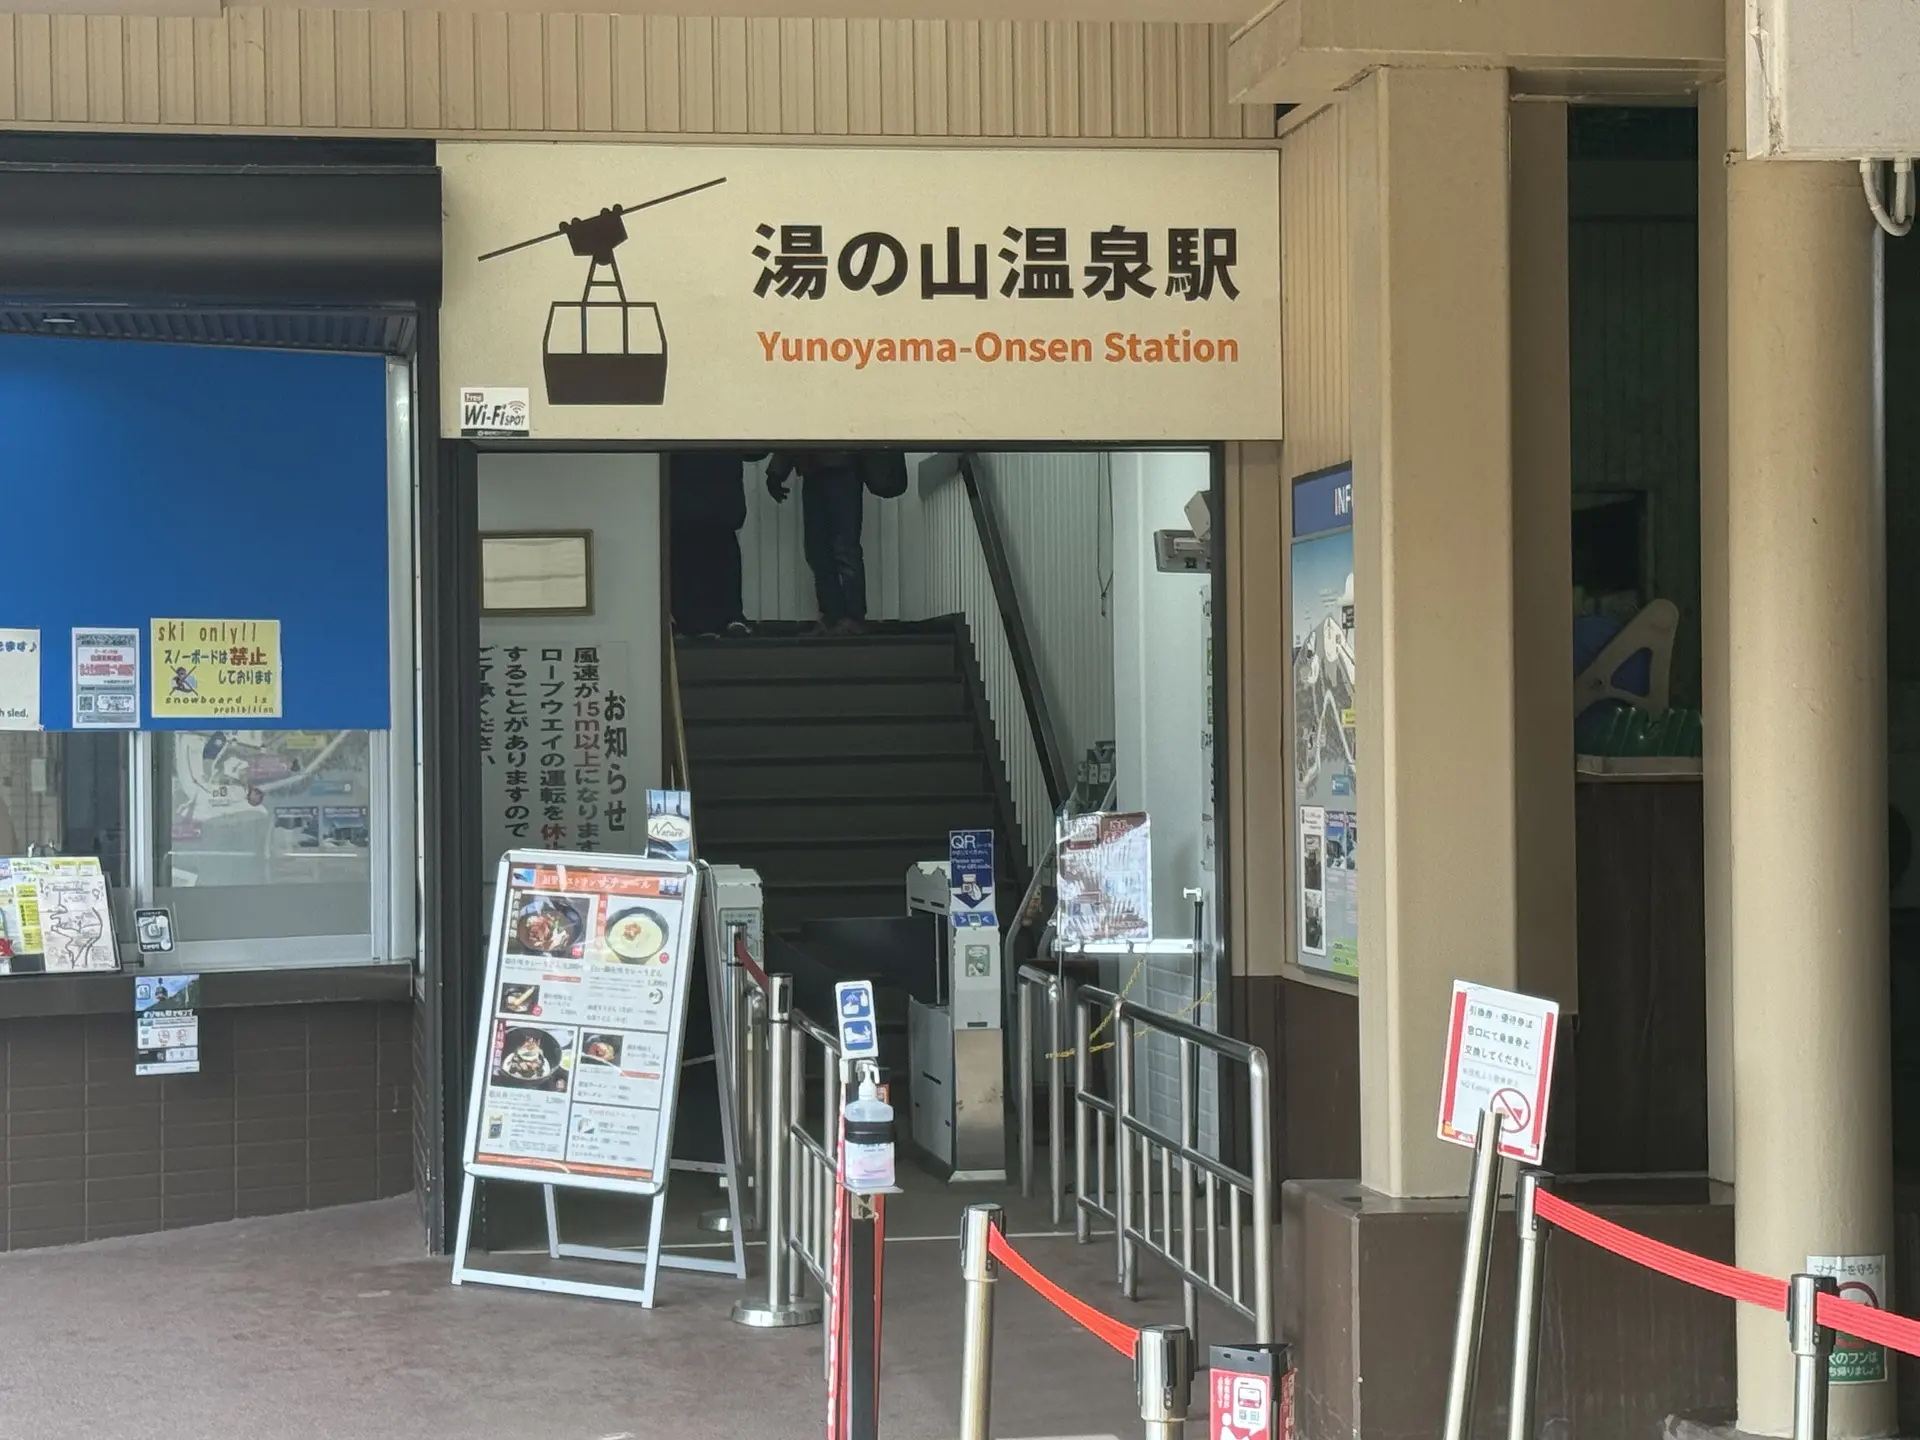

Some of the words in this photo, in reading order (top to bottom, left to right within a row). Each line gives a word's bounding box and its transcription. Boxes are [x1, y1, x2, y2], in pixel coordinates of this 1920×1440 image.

[752, 223, 1240, 301] 湯の山温泉駅
[757, 331, 1092, 370] Yunoyama-Onsen
[1104, 329, 1238, 363] Station
[465, 404, 506, 426] Wi-Fi
[158, 621, 184, 642] ski
[164, 647, 268, 665] スノーボードは禁止
[218, 669, 272, 685] しております
[165, 695, 242, 704] snowboard
[503, 646, 530, 837] することがありますので
[603, 690, 628, 832] お知らせ
